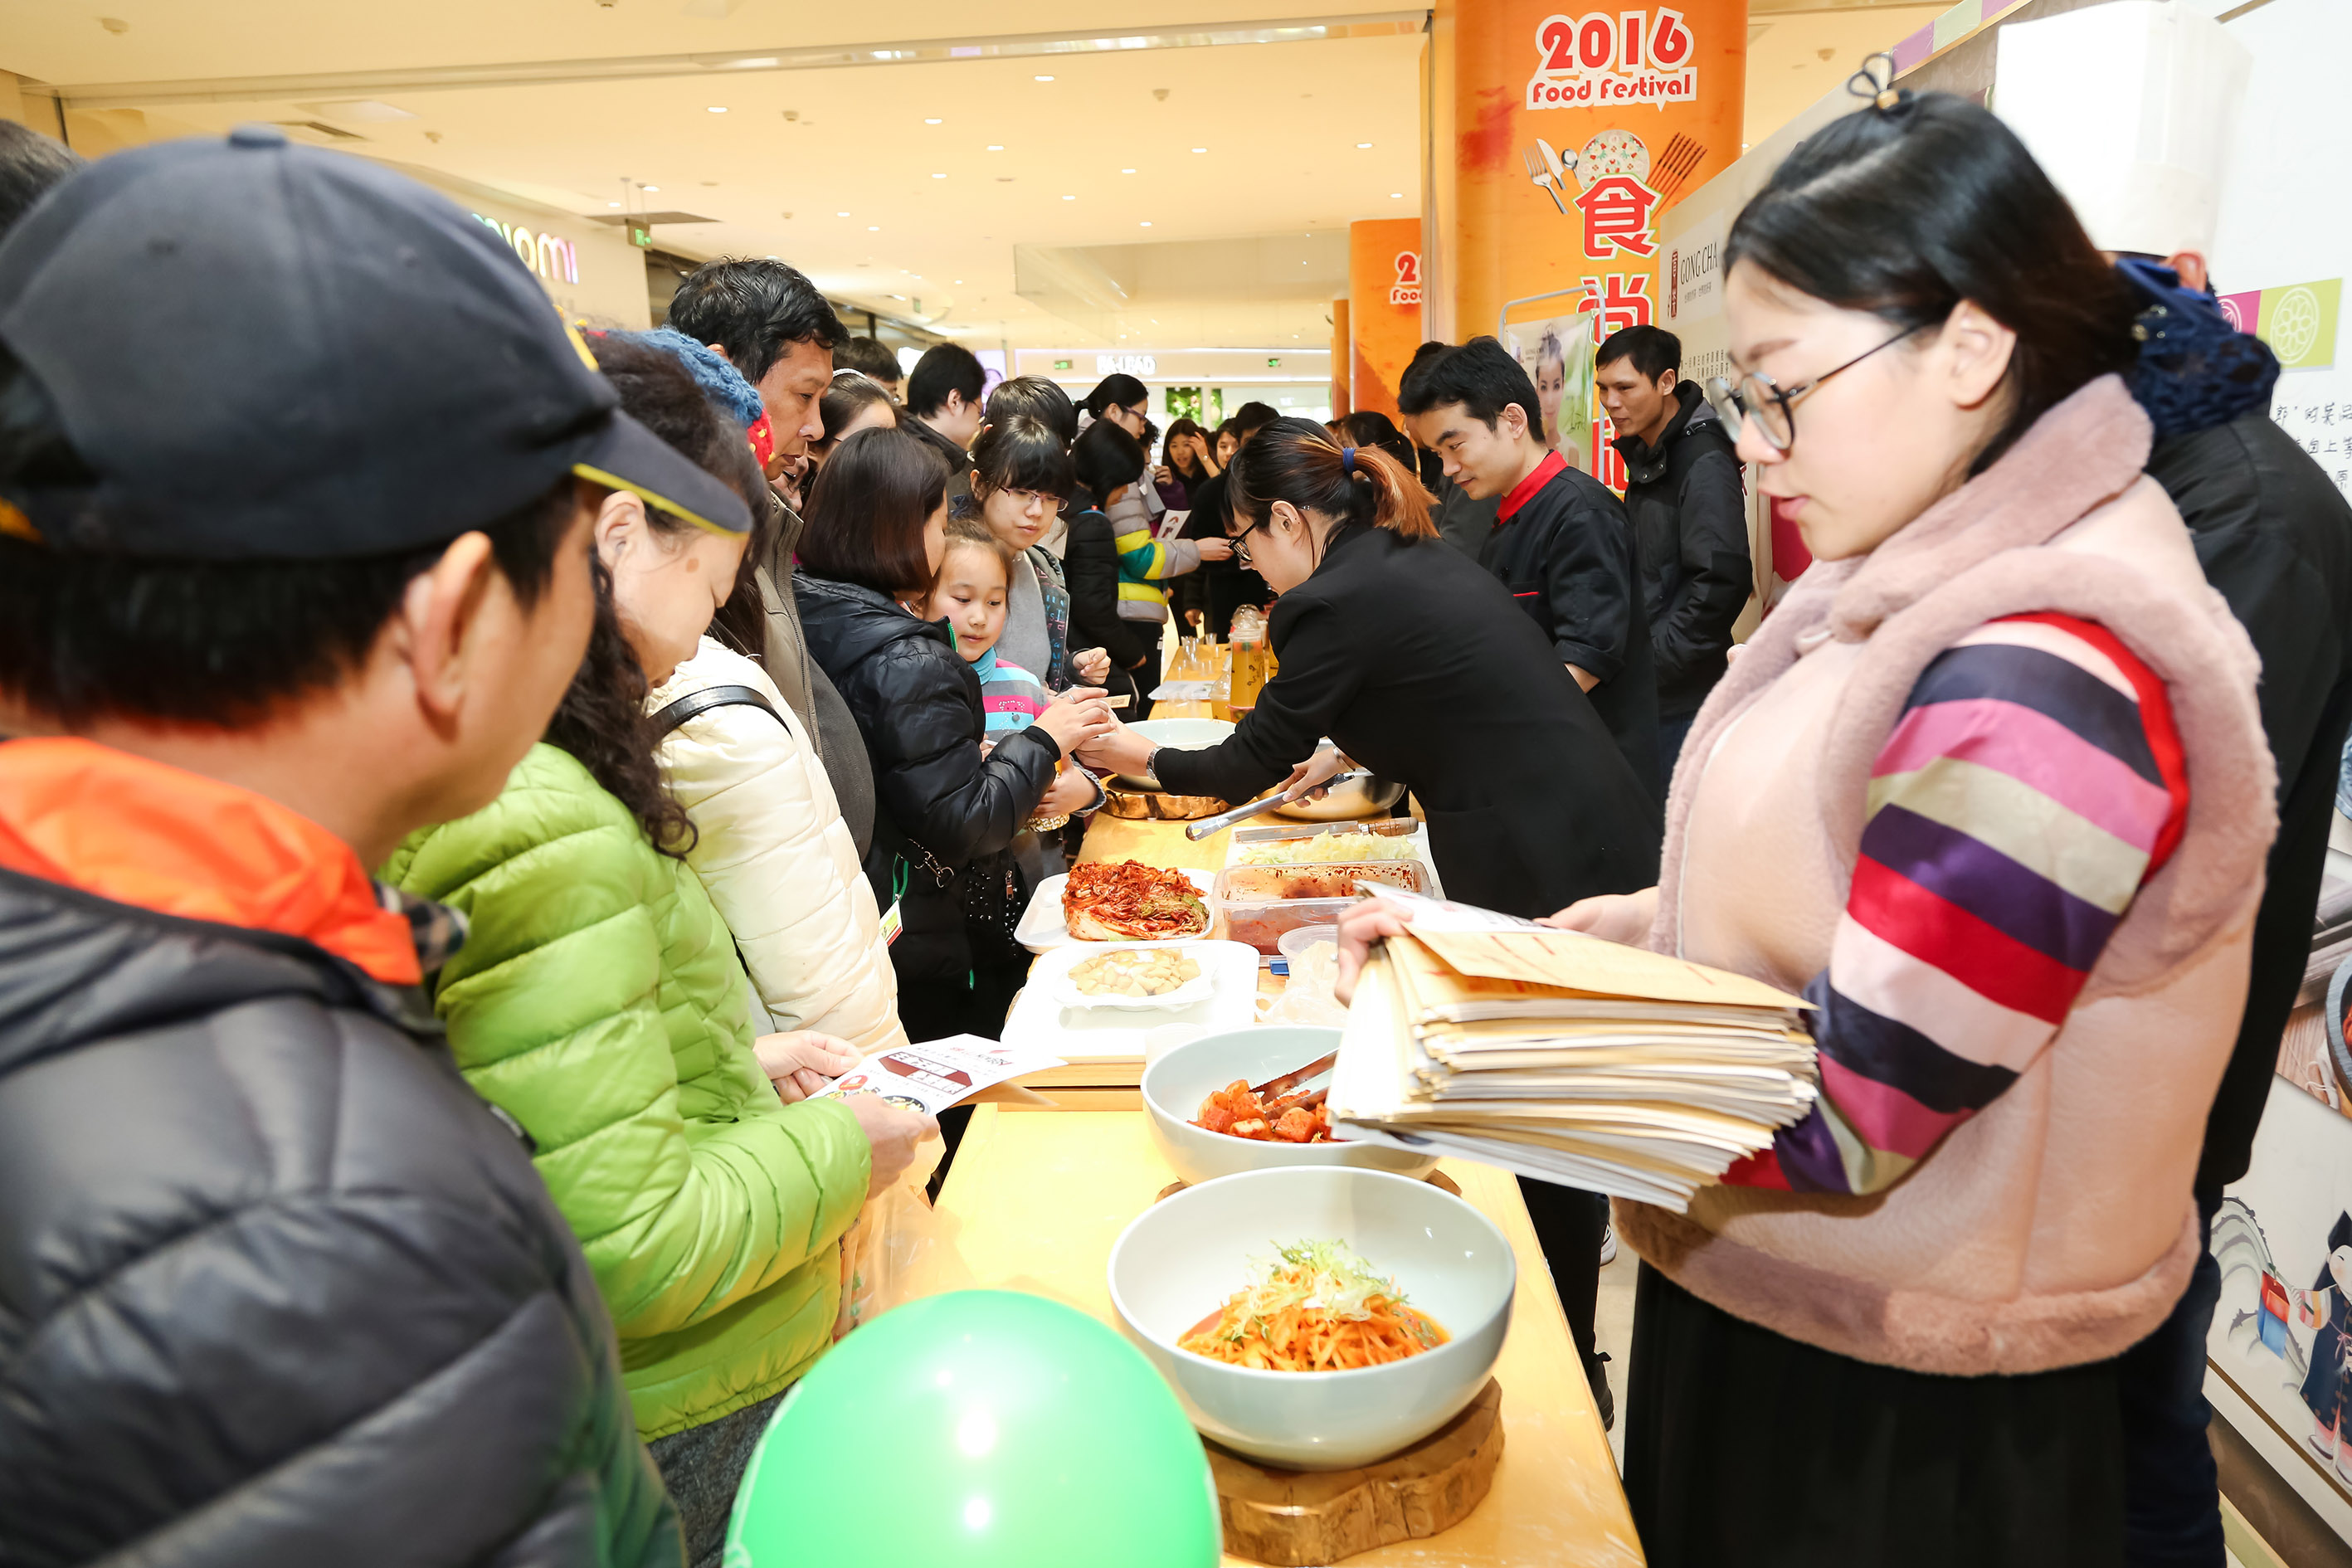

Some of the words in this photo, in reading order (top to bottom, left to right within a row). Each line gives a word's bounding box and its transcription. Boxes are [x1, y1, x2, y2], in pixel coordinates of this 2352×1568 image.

[1542, 15, 1687, 70] 2016
[1533, 80, 1591, 103] Food
[1600, 74, 1691, 100] Festival
[1398, 254, 1422, 282] 2
[1681, 251, 1701, 285] GONG
[1702, 241, 1717, 274] CHA
[1393, 290, 1422, 301] Foo
